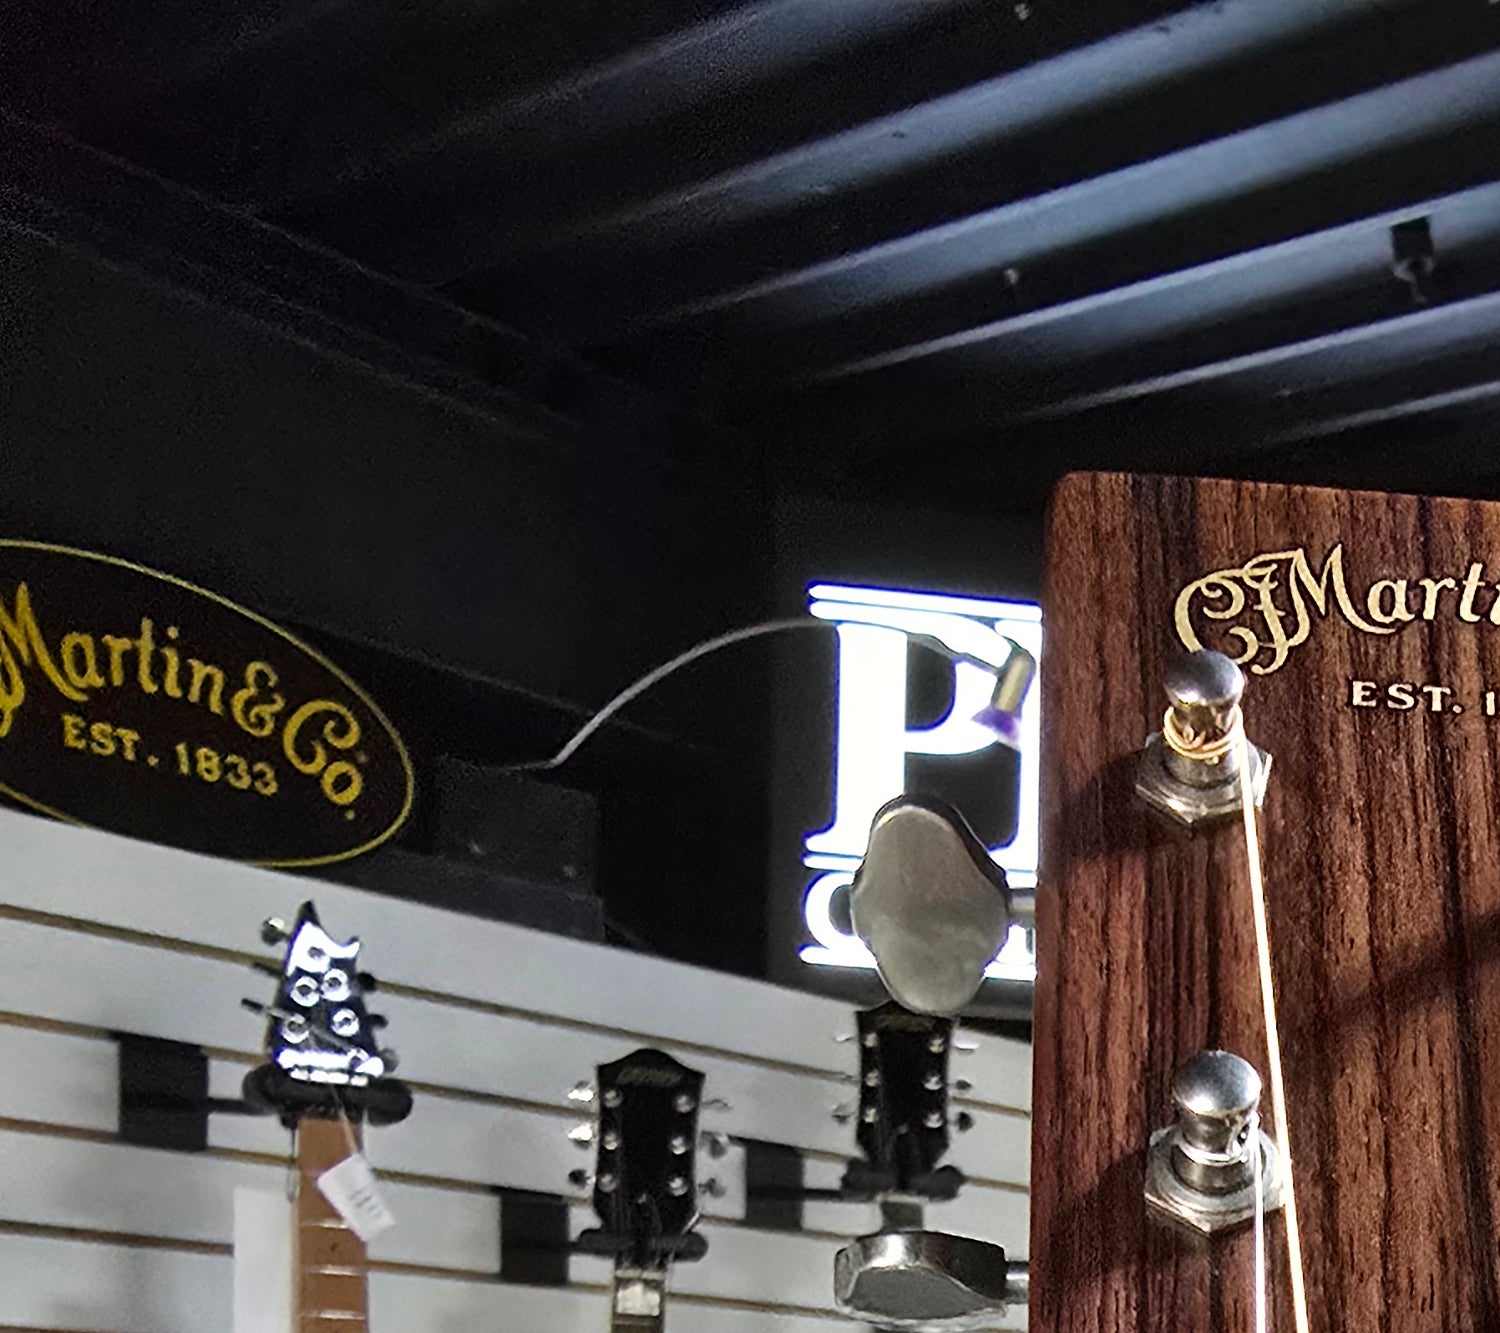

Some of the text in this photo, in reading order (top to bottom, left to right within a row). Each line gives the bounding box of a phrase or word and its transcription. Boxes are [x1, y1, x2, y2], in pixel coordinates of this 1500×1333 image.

[1351, 680, 1462, 716] EST.
[62, 713, 279, 797] EST. 1833
